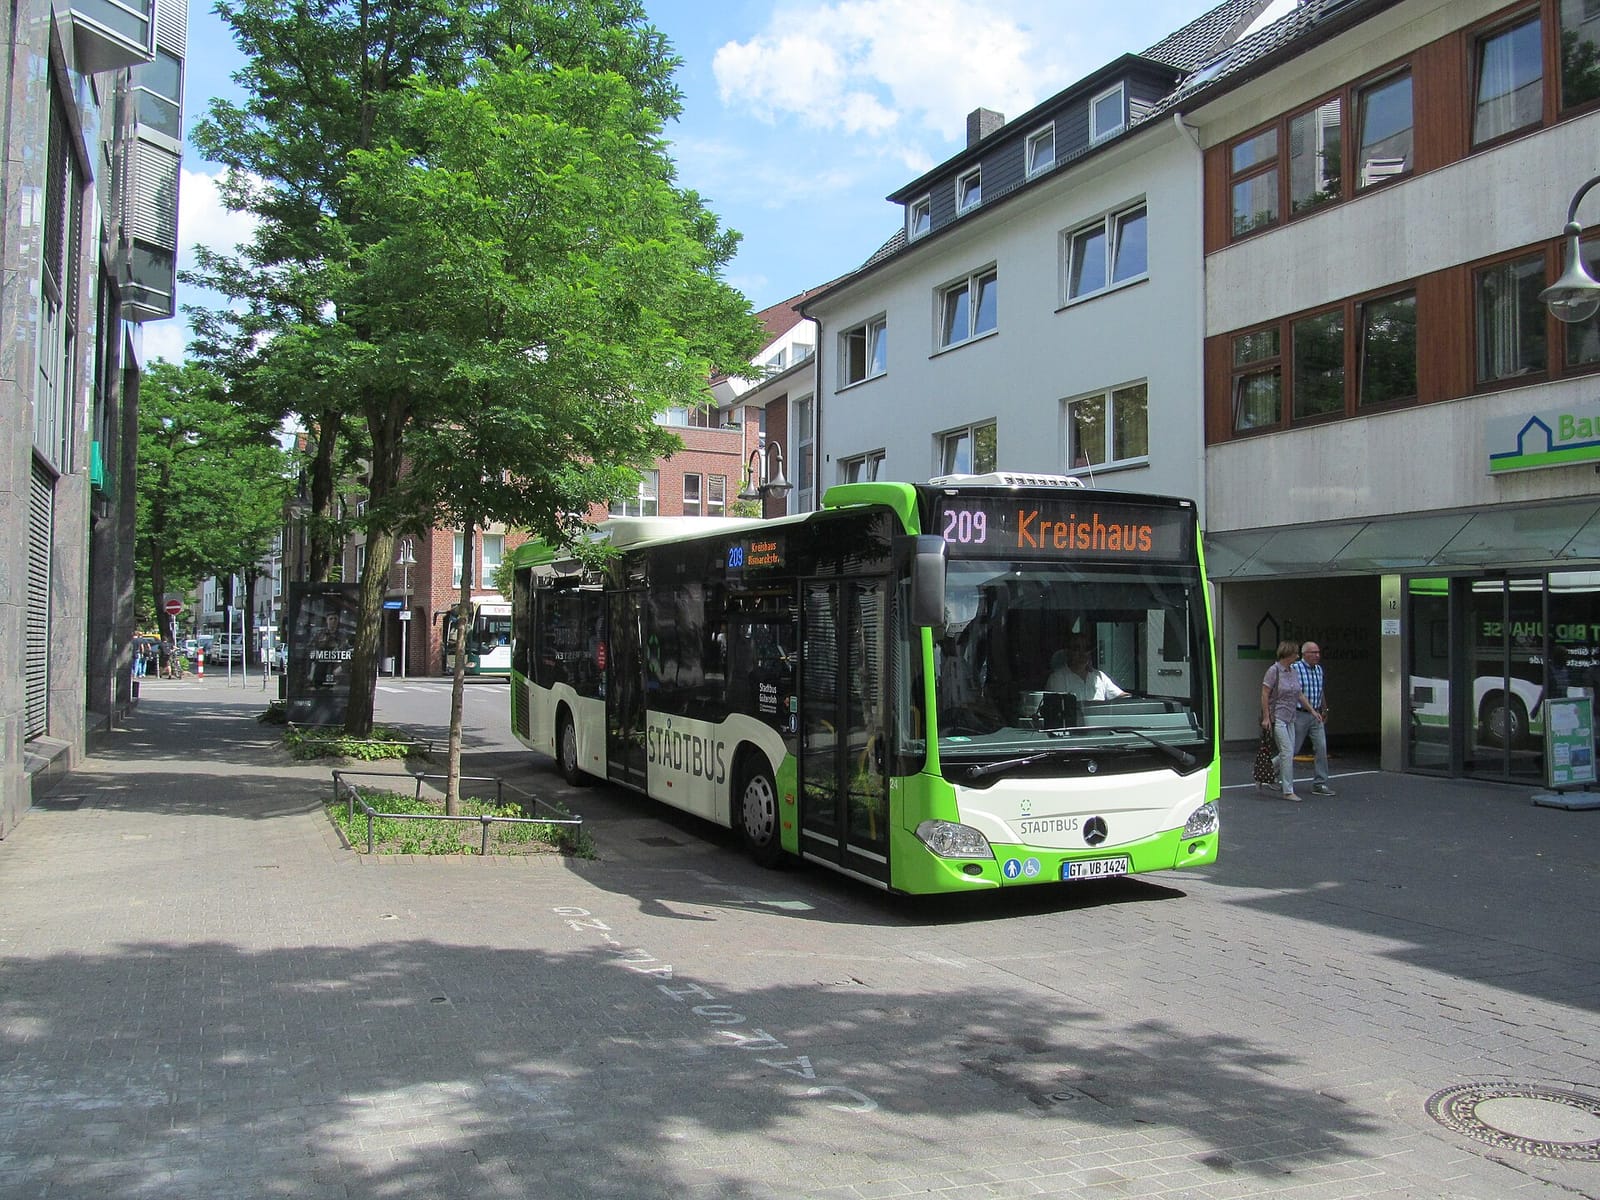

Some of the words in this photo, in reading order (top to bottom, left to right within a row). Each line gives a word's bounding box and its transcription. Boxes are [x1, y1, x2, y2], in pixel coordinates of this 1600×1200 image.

[943, 509, 987, 544] 209
[1016, 509, 1153, 553] Kreishaus
[728, 547, 743, 567] 209
[751, 542, 777, 553] Kreishaus
[1389, 600, 1396, 610] 12
[648, 725, 726, 785] STADTBUS
[1020, 817, 1079, 835] STADTBUS
[1069, 863, 1082, 877] GT
[1090, 862, 1102, 875] VB
[1103, 859, 1126, 874] 1424
